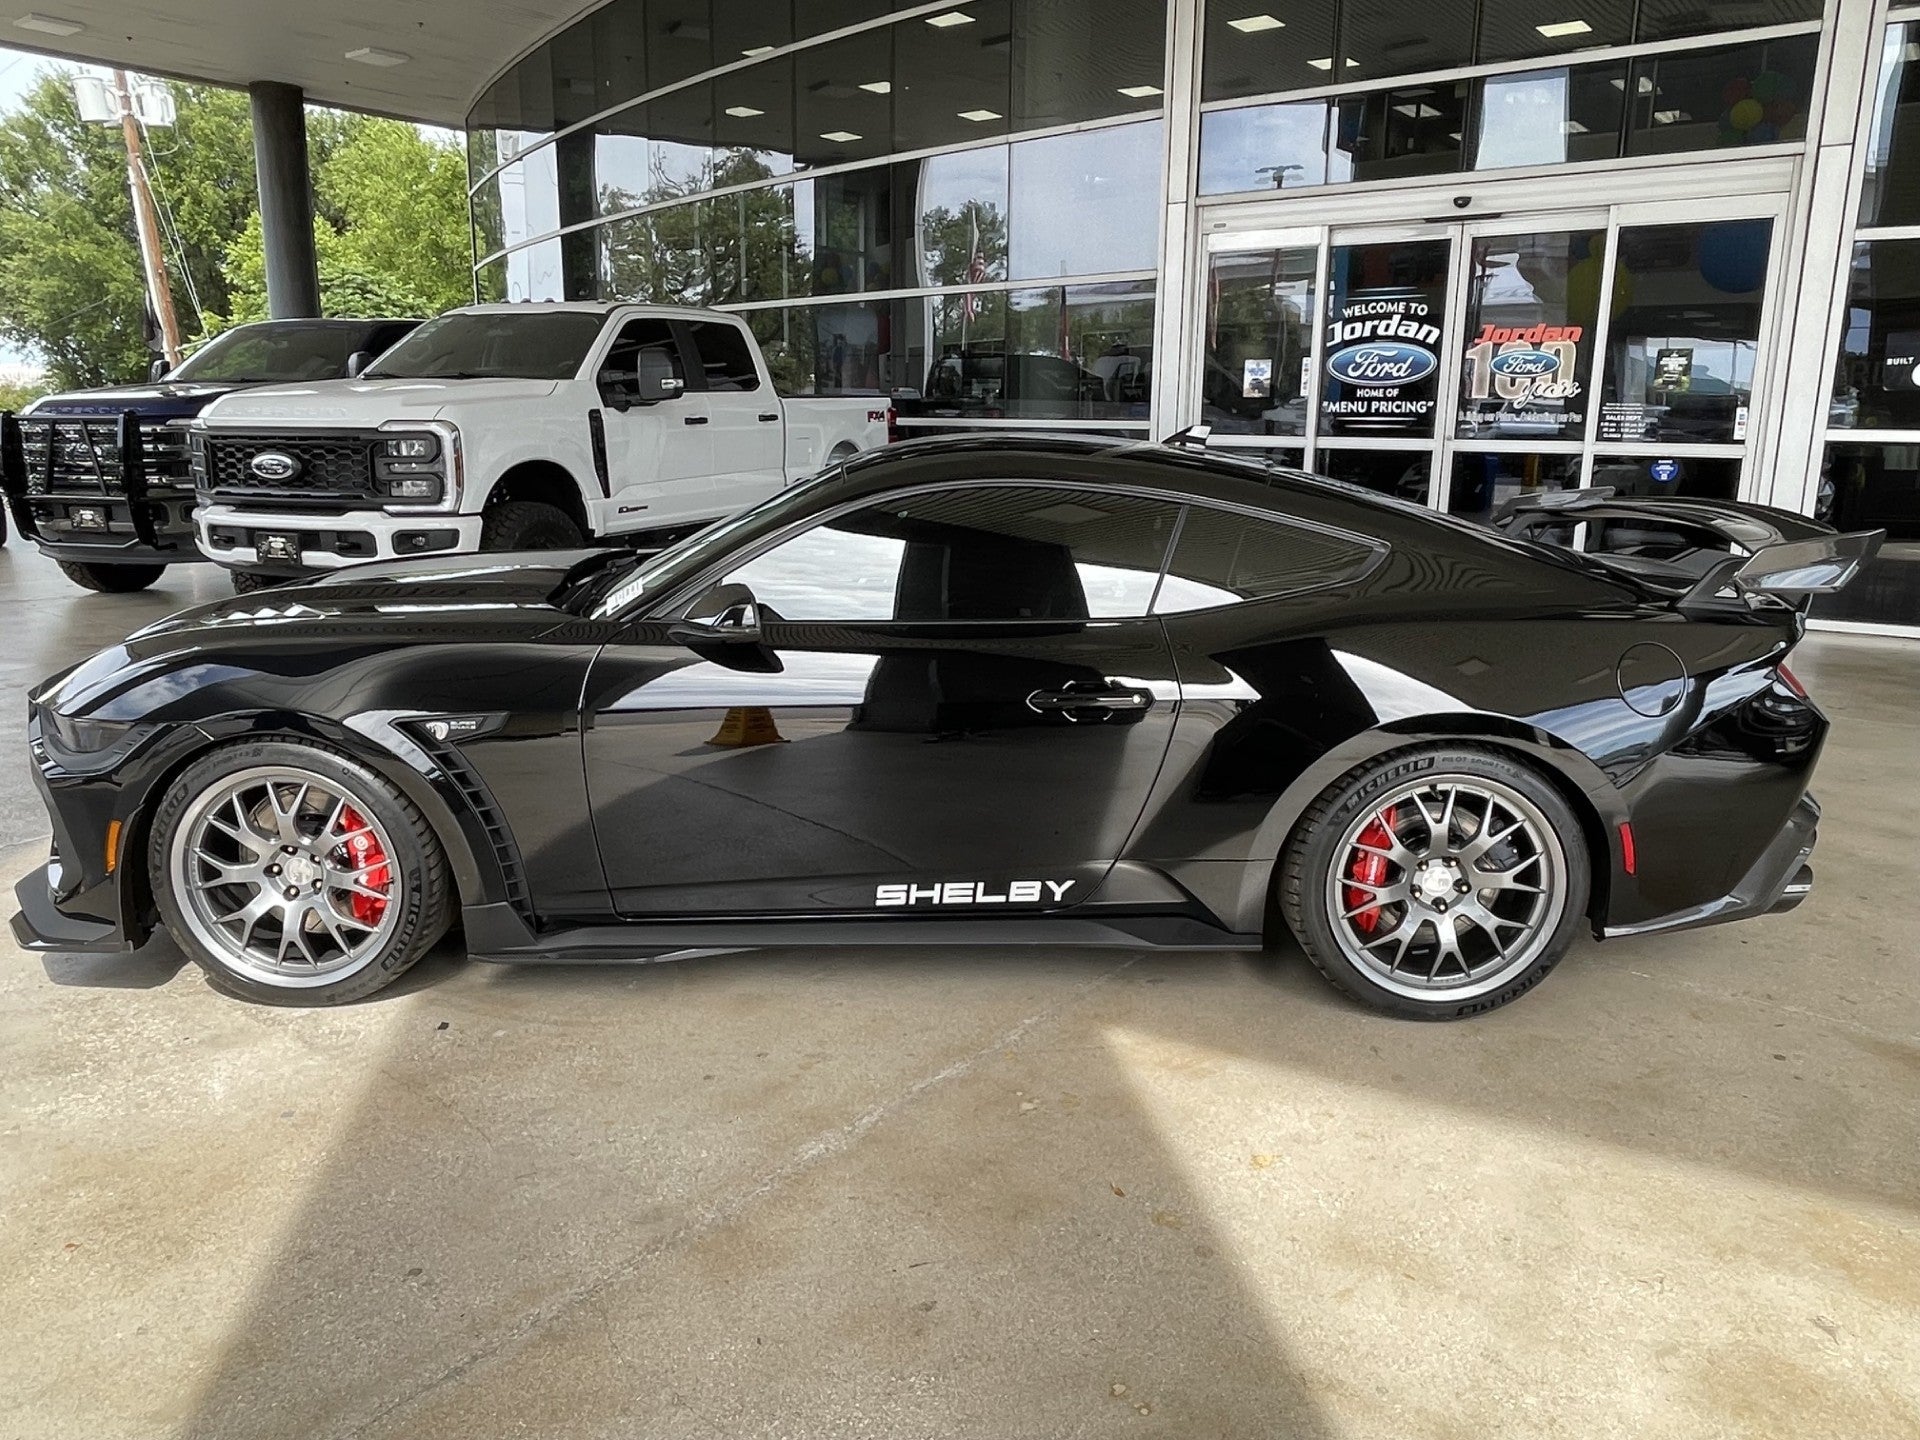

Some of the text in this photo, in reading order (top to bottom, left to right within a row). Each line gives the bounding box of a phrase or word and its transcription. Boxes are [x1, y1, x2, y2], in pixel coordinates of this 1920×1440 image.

[1342, 302, 1428, 318] WELCOME TO
[1326, 314, 1440, 347] Jordan
[1474, 323, 1583, 344] Jordan
[1347, 349, 1415, 378] Ford
[1503, 355, 1545, 373] Ford
[1886, 357, 1914, 366] BUILT
[1356, 388, 1399, 398] HOME OF
[1322, 401, 1434, 413] "MENU PRICING"
[1345, 756, 1435, 810] MICHELIN
[875, 880, 1076, 906] SHELBY
